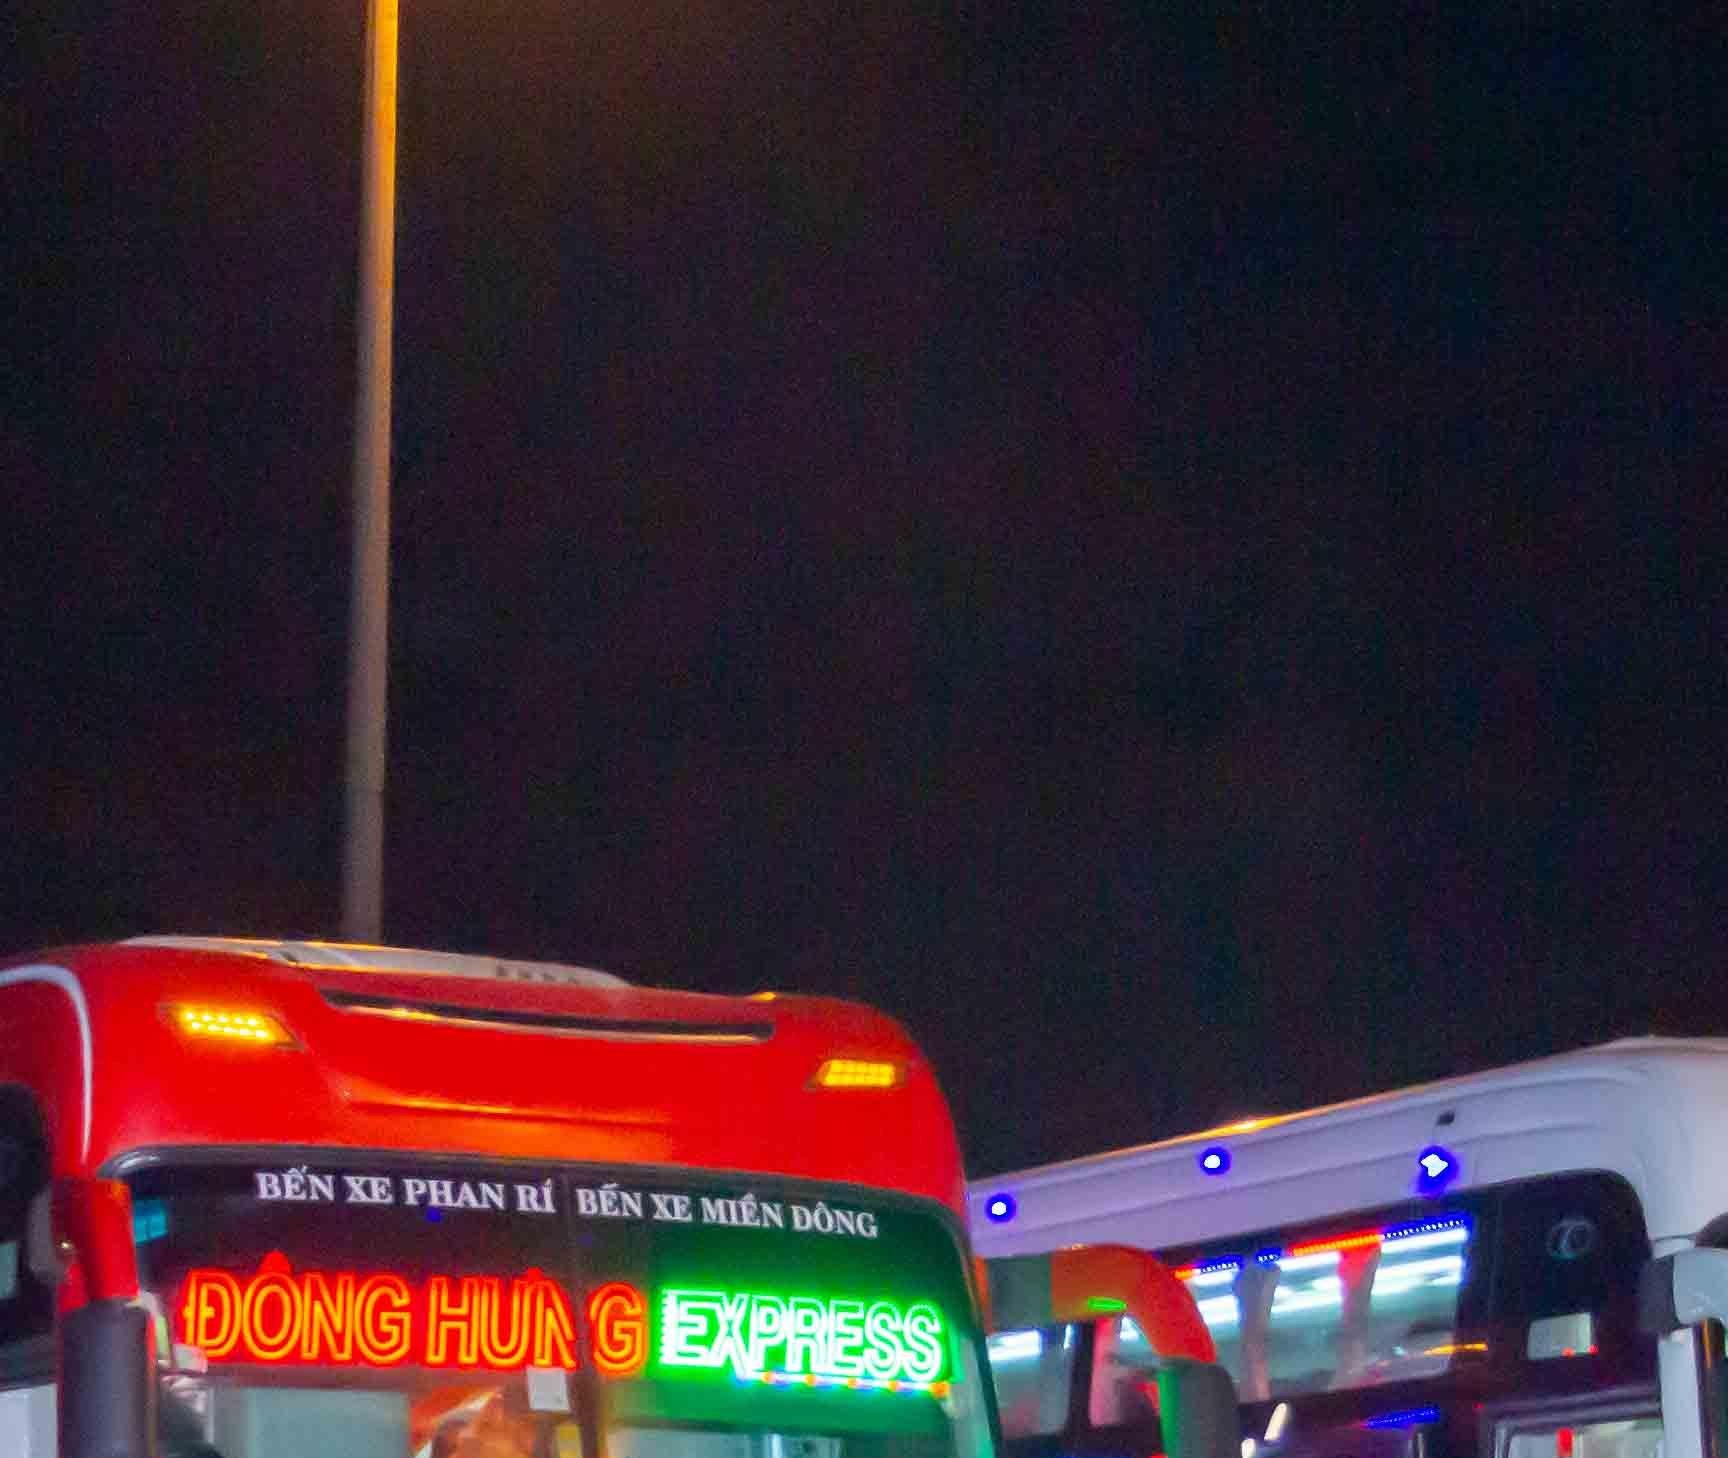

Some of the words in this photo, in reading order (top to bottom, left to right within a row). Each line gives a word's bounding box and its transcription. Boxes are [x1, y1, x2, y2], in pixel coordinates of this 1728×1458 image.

[255, 1165, 335, 1201] BẾN
[343, 1175, 394, 1204] XE
[402, 1178, 506, 1210] PHAN
[575, 1183, 643, 1218] BẾN
[650, 1193, 693, 1222] XE
[660, 1288, 944, 1383] EXPRESS
